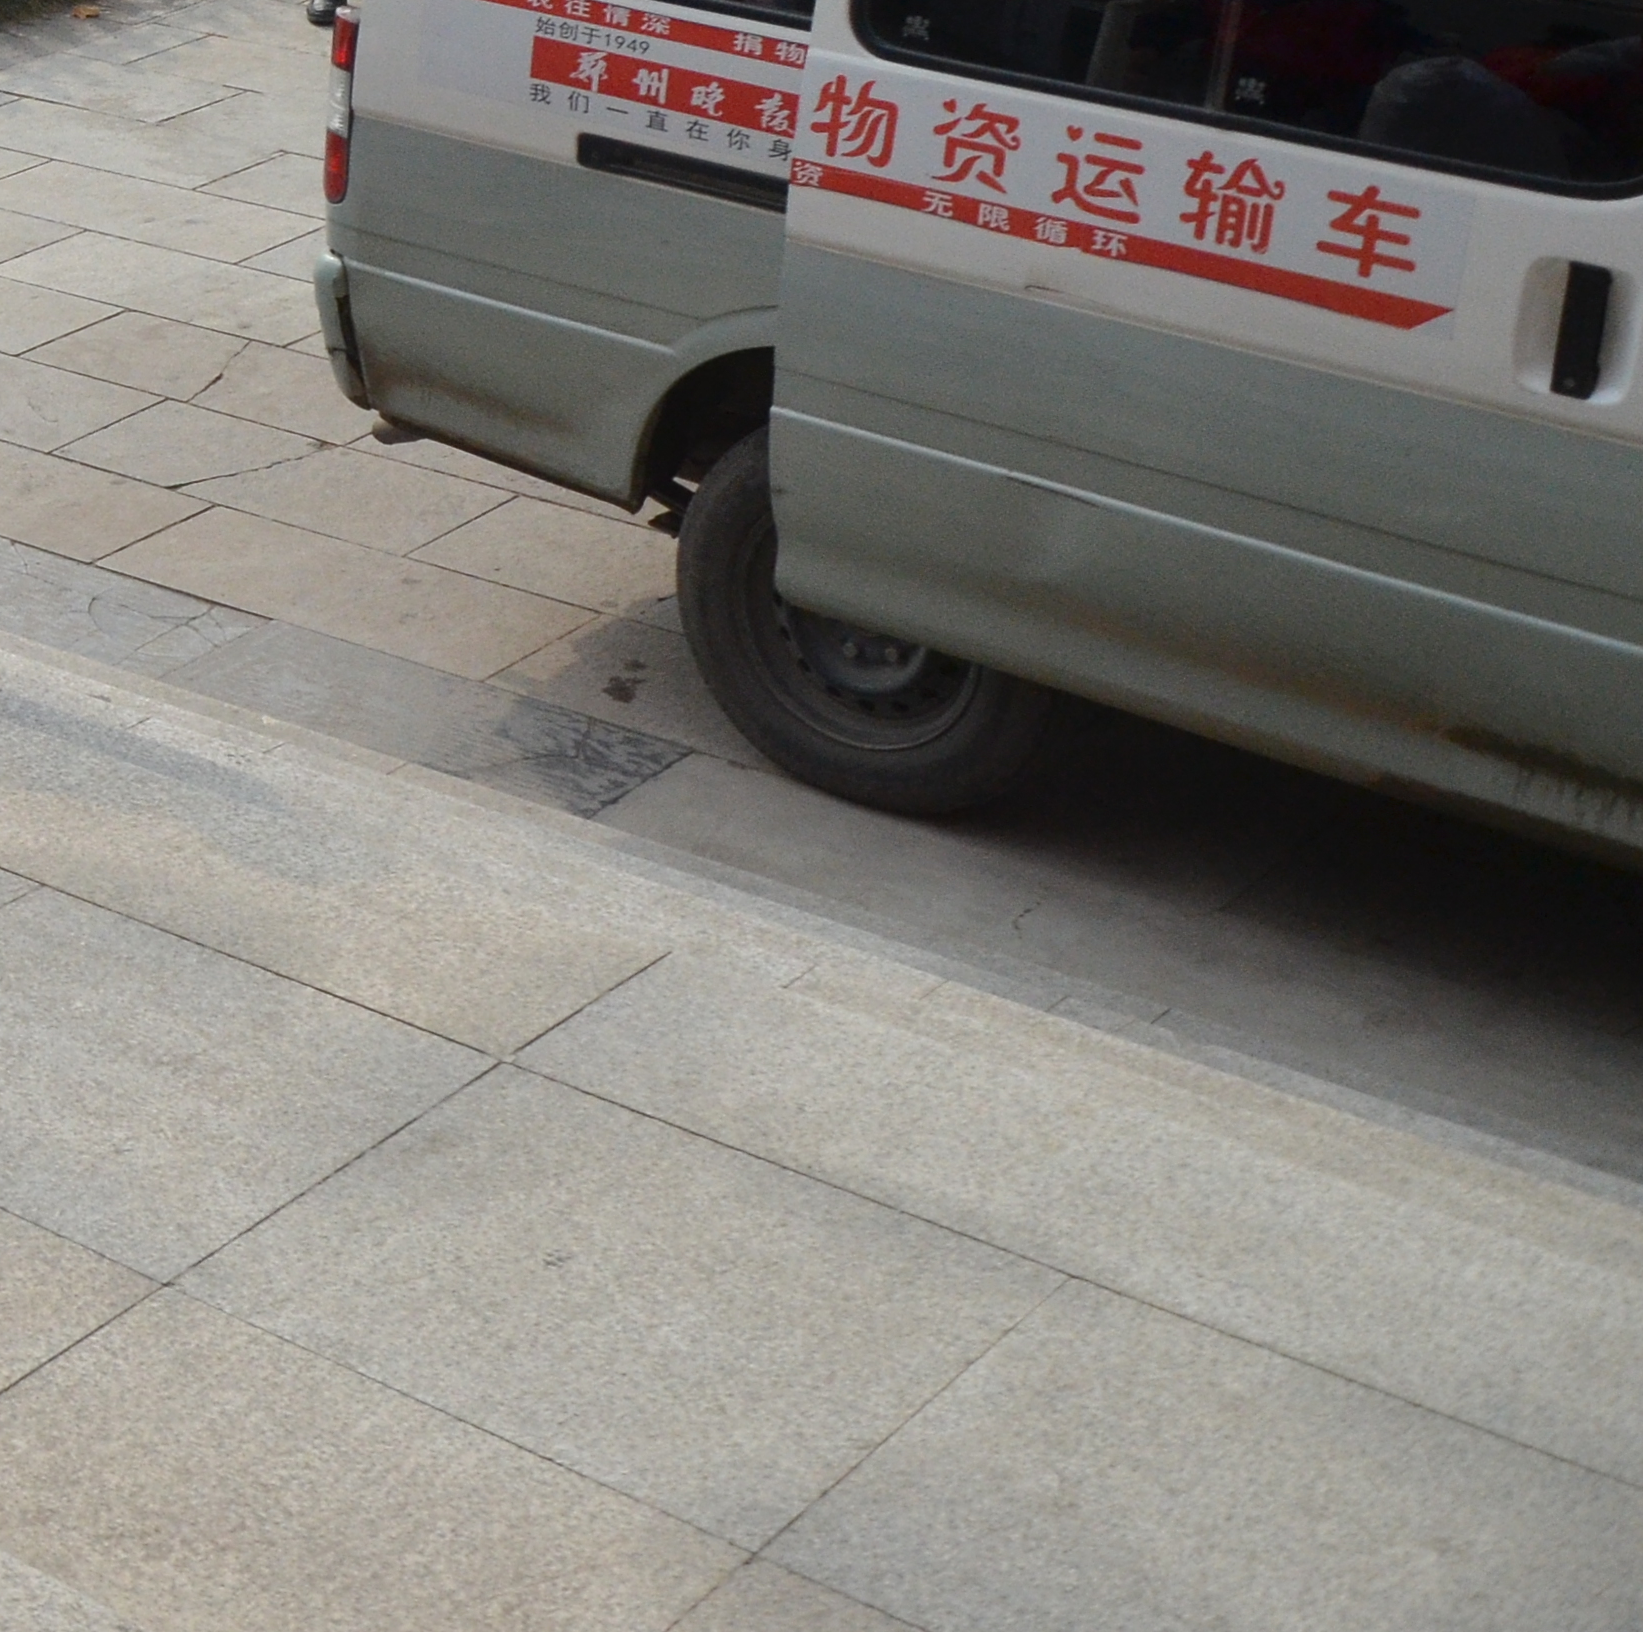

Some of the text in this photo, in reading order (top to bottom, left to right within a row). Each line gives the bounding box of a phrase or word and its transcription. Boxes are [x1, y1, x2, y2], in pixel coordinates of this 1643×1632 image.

[535, 15, 651, 55] 始创于1949
[528, 81, 793, 162] 我们一直在你身
[810, 74, 1422, 278] 物资运输车
[921, 189, 1129, 258] 无限循环
